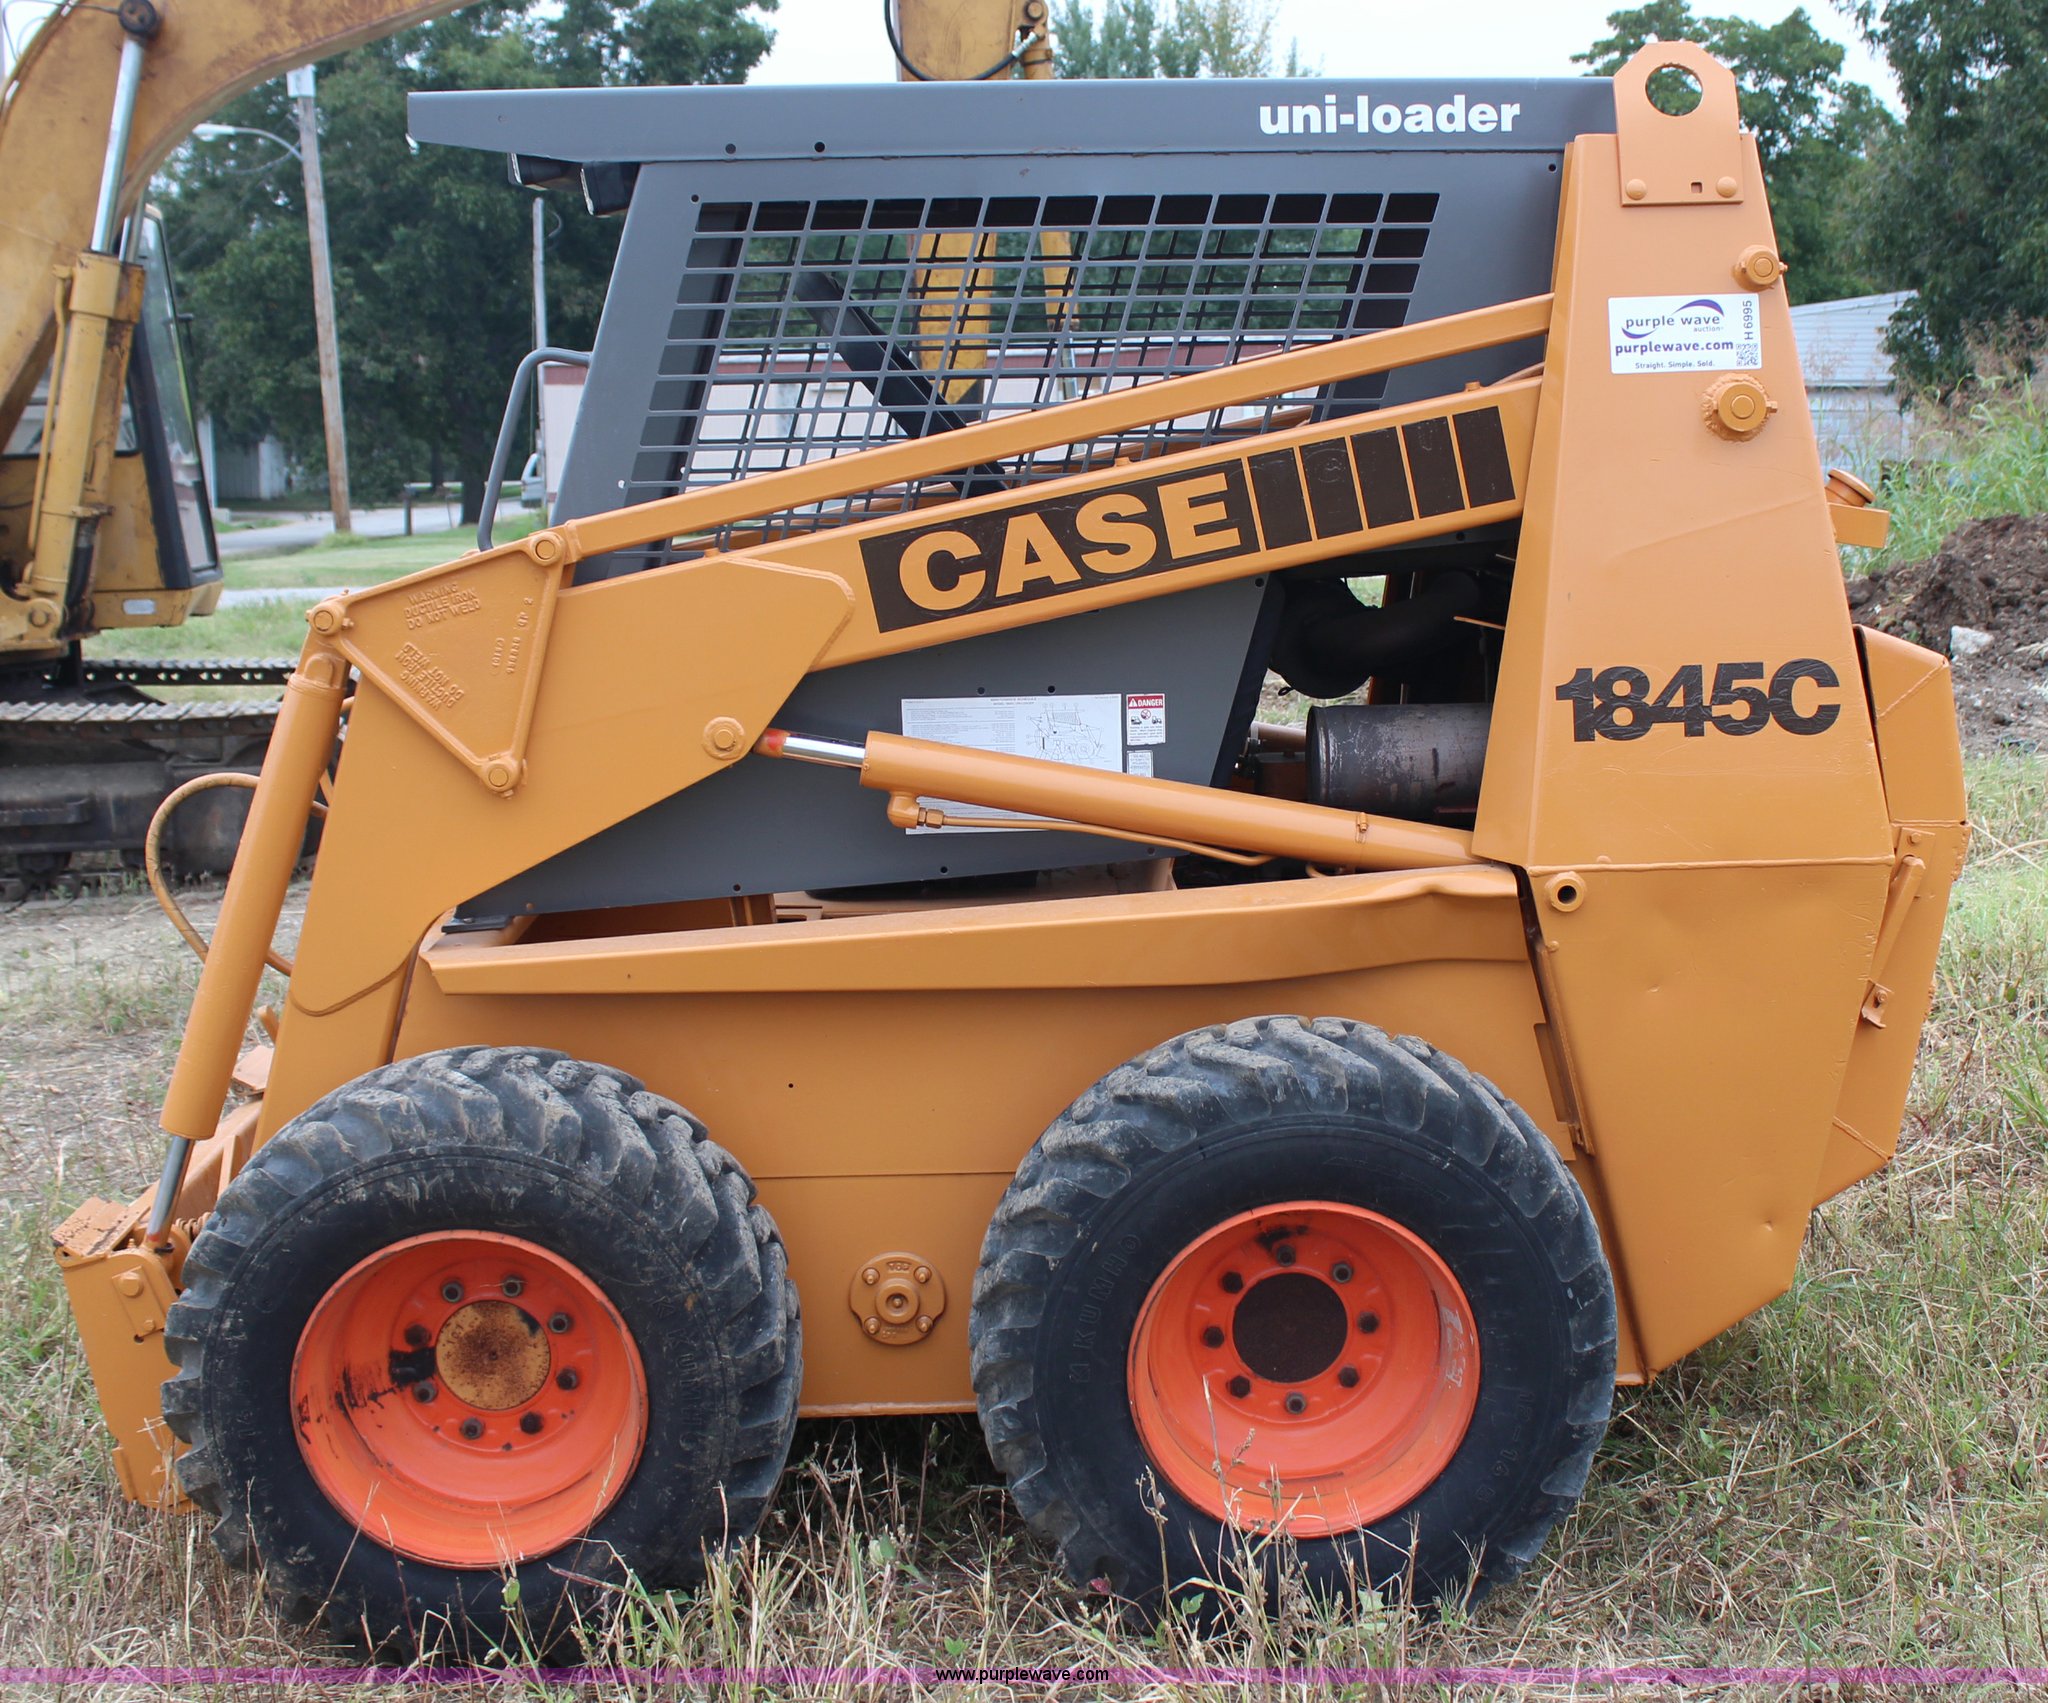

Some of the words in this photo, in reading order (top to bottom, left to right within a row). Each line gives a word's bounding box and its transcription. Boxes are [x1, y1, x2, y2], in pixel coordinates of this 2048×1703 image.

[1259, 94, 1521, 135] uni-loader
[1626, 315, 1675, 329] purple
[1680, 315, 1721, 326] wave
[1615, 339, 1734, 356] purplewave.com
[1635, 361, 1665, 370] Straight.
[1667, 360, 1695, 369] Simple.
[1697, 359, 1716, 368] Sold.
[899, 473, 1241, 612] CASE
[1137, 698, 1163, 708] DANGER
[1555, 657, 1841, 742] 1845C
